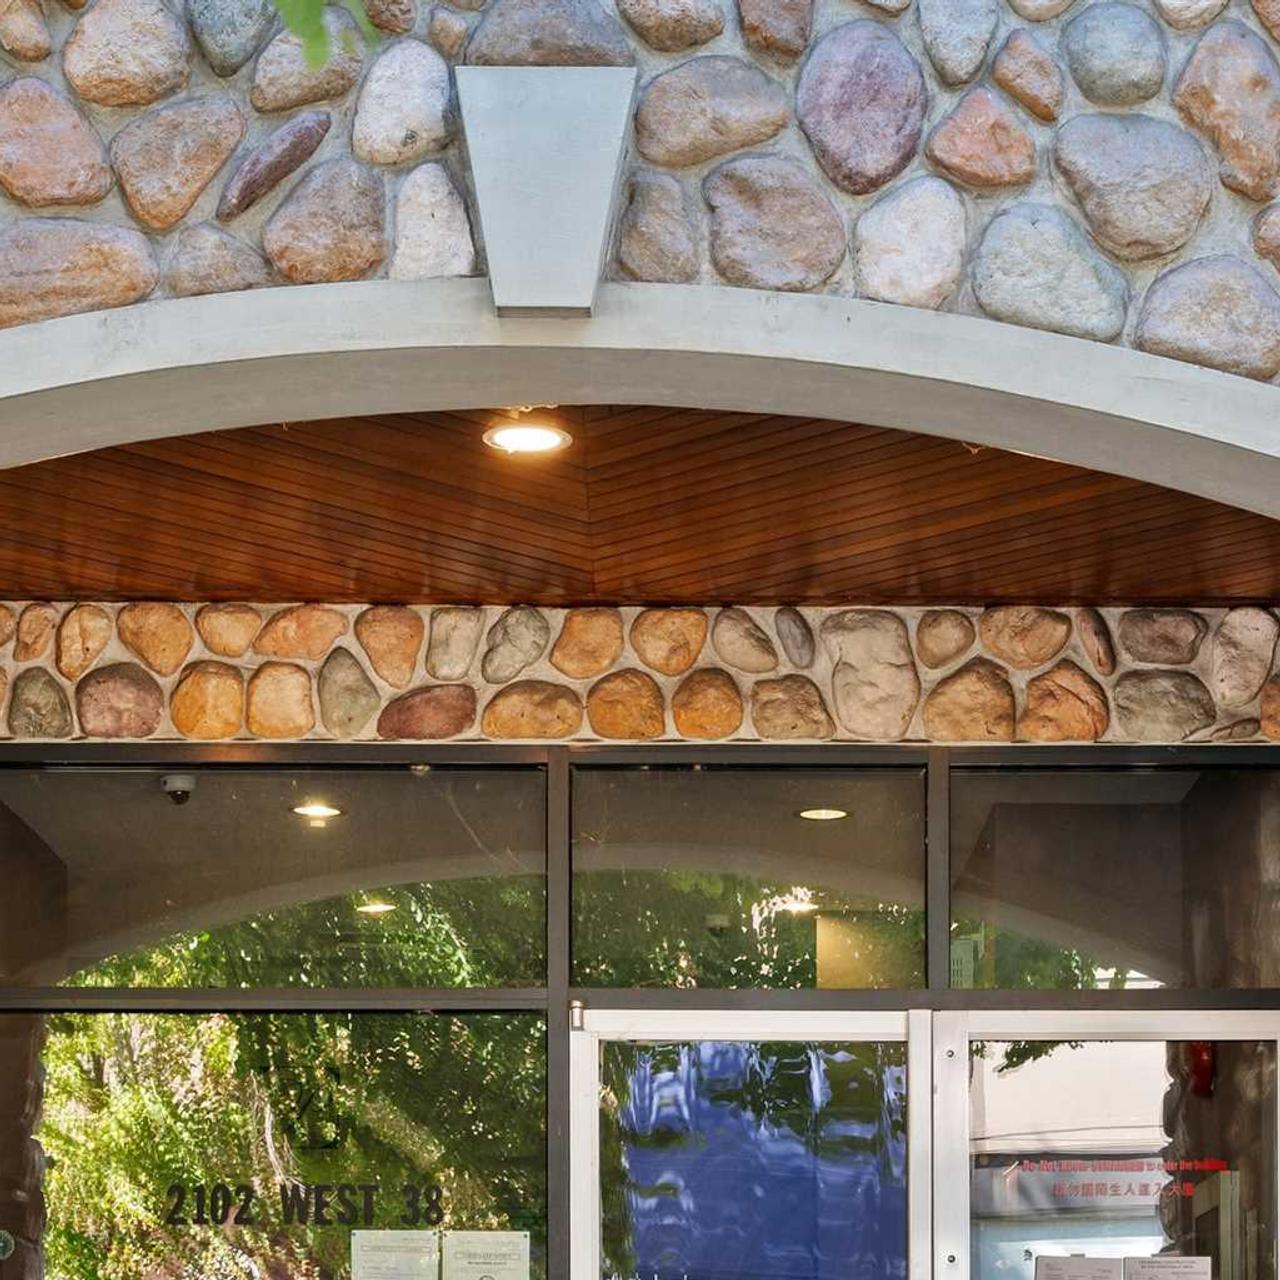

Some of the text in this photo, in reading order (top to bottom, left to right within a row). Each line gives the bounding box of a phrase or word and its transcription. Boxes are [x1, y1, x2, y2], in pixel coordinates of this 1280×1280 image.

[166, 1184, 445, 1226] 2102 WEST 38
